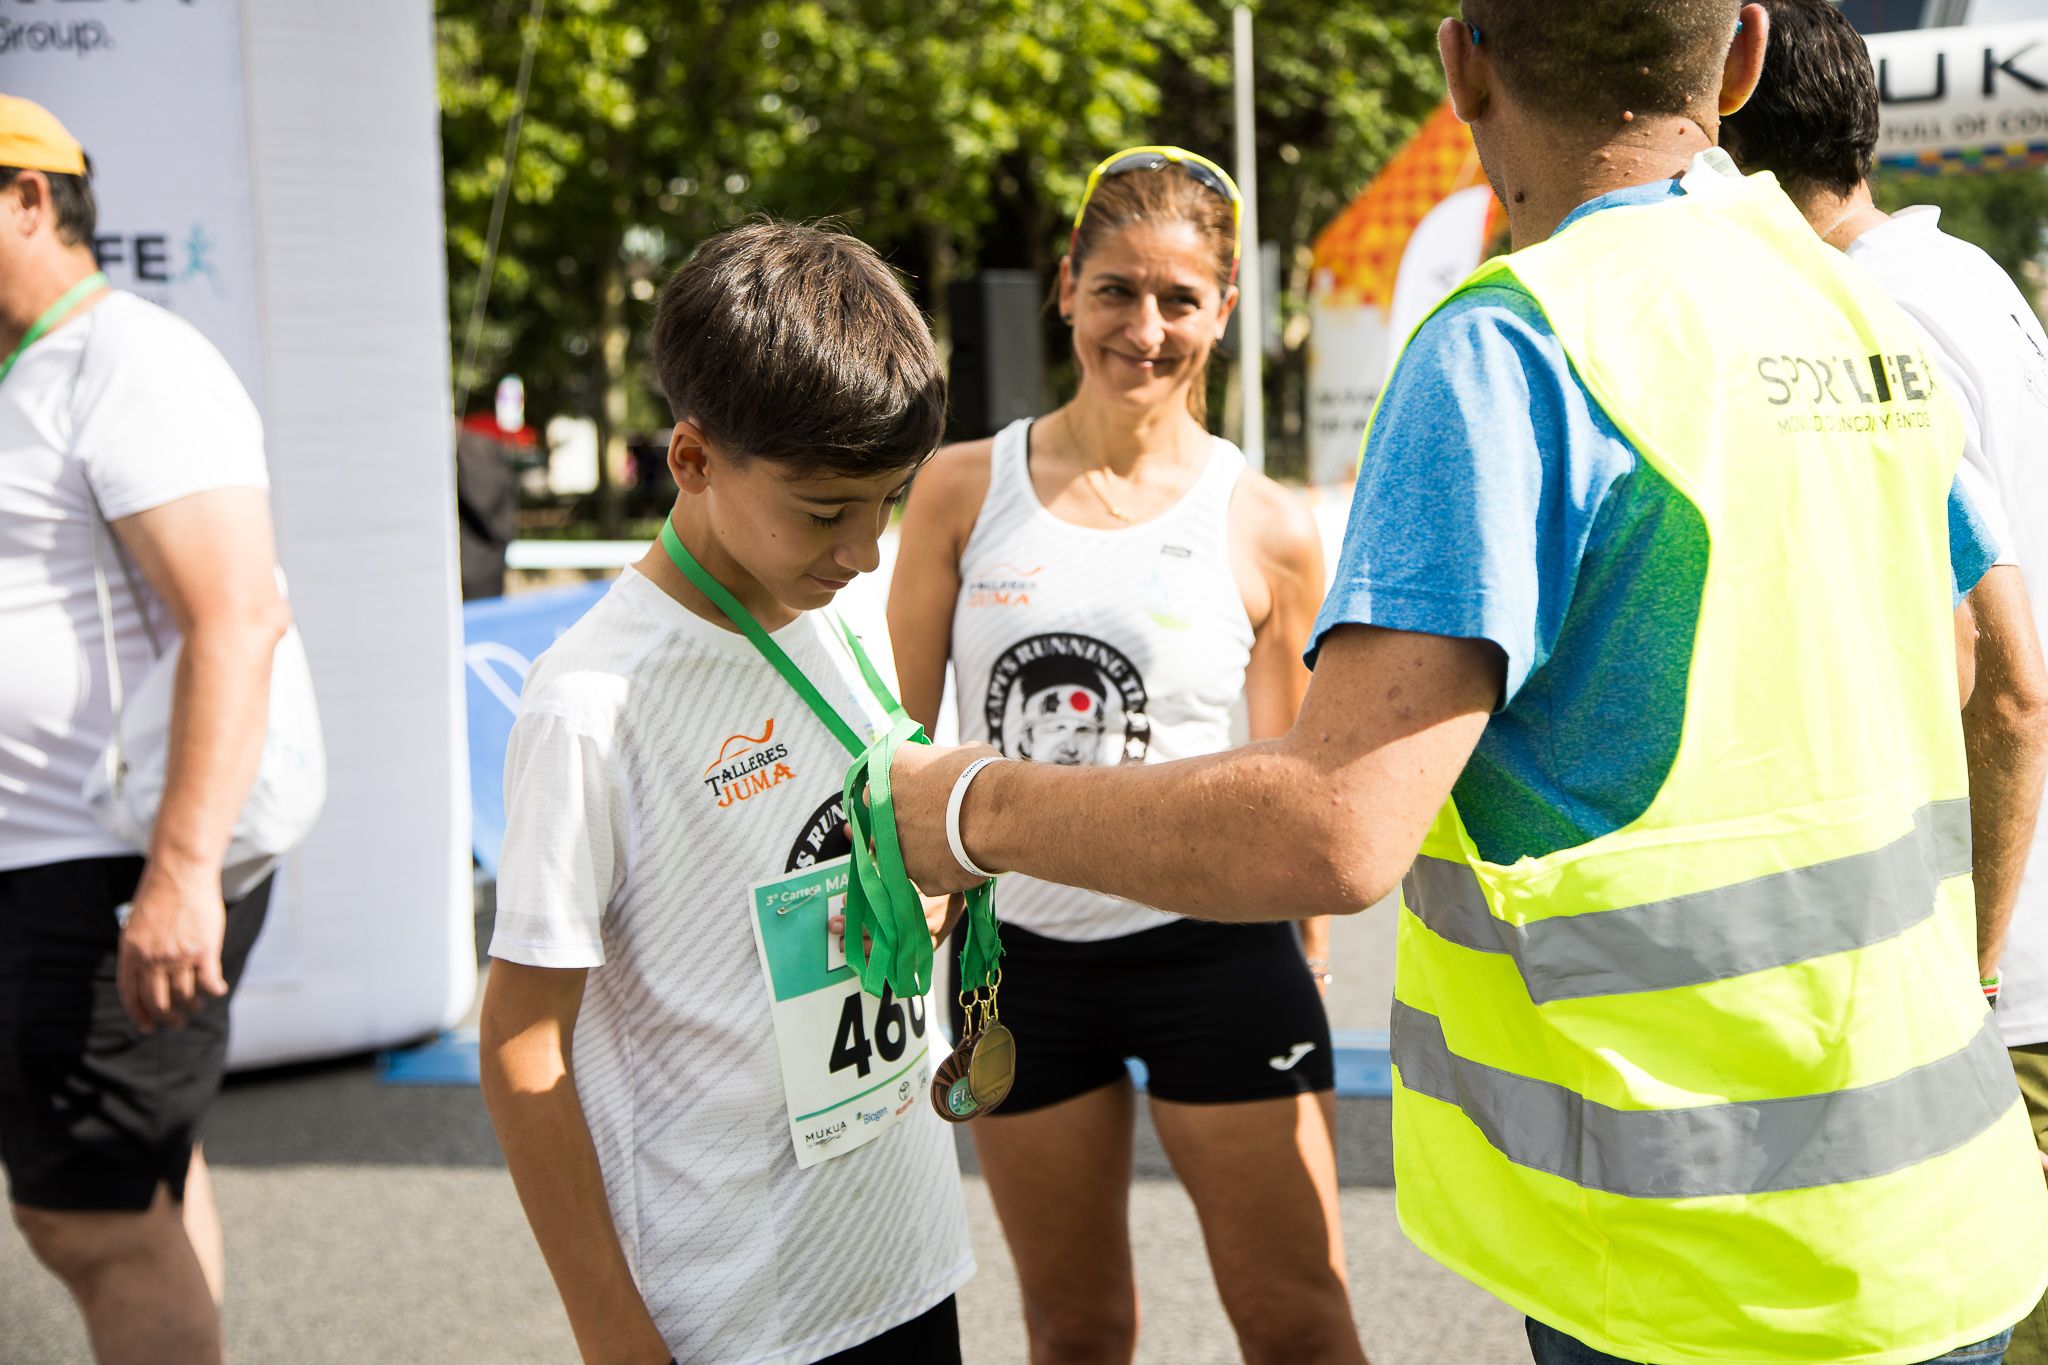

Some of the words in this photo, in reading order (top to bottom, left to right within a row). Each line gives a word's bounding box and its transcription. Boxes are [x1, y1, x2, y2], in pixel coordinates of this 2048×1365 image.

[1013, 635, 1128, 681] RUNNING
[704, 743, 788, 797] TALLERES
[718, 763, 796, 807] JUMA
[805, 1121, 847, 1143] MUKUA
